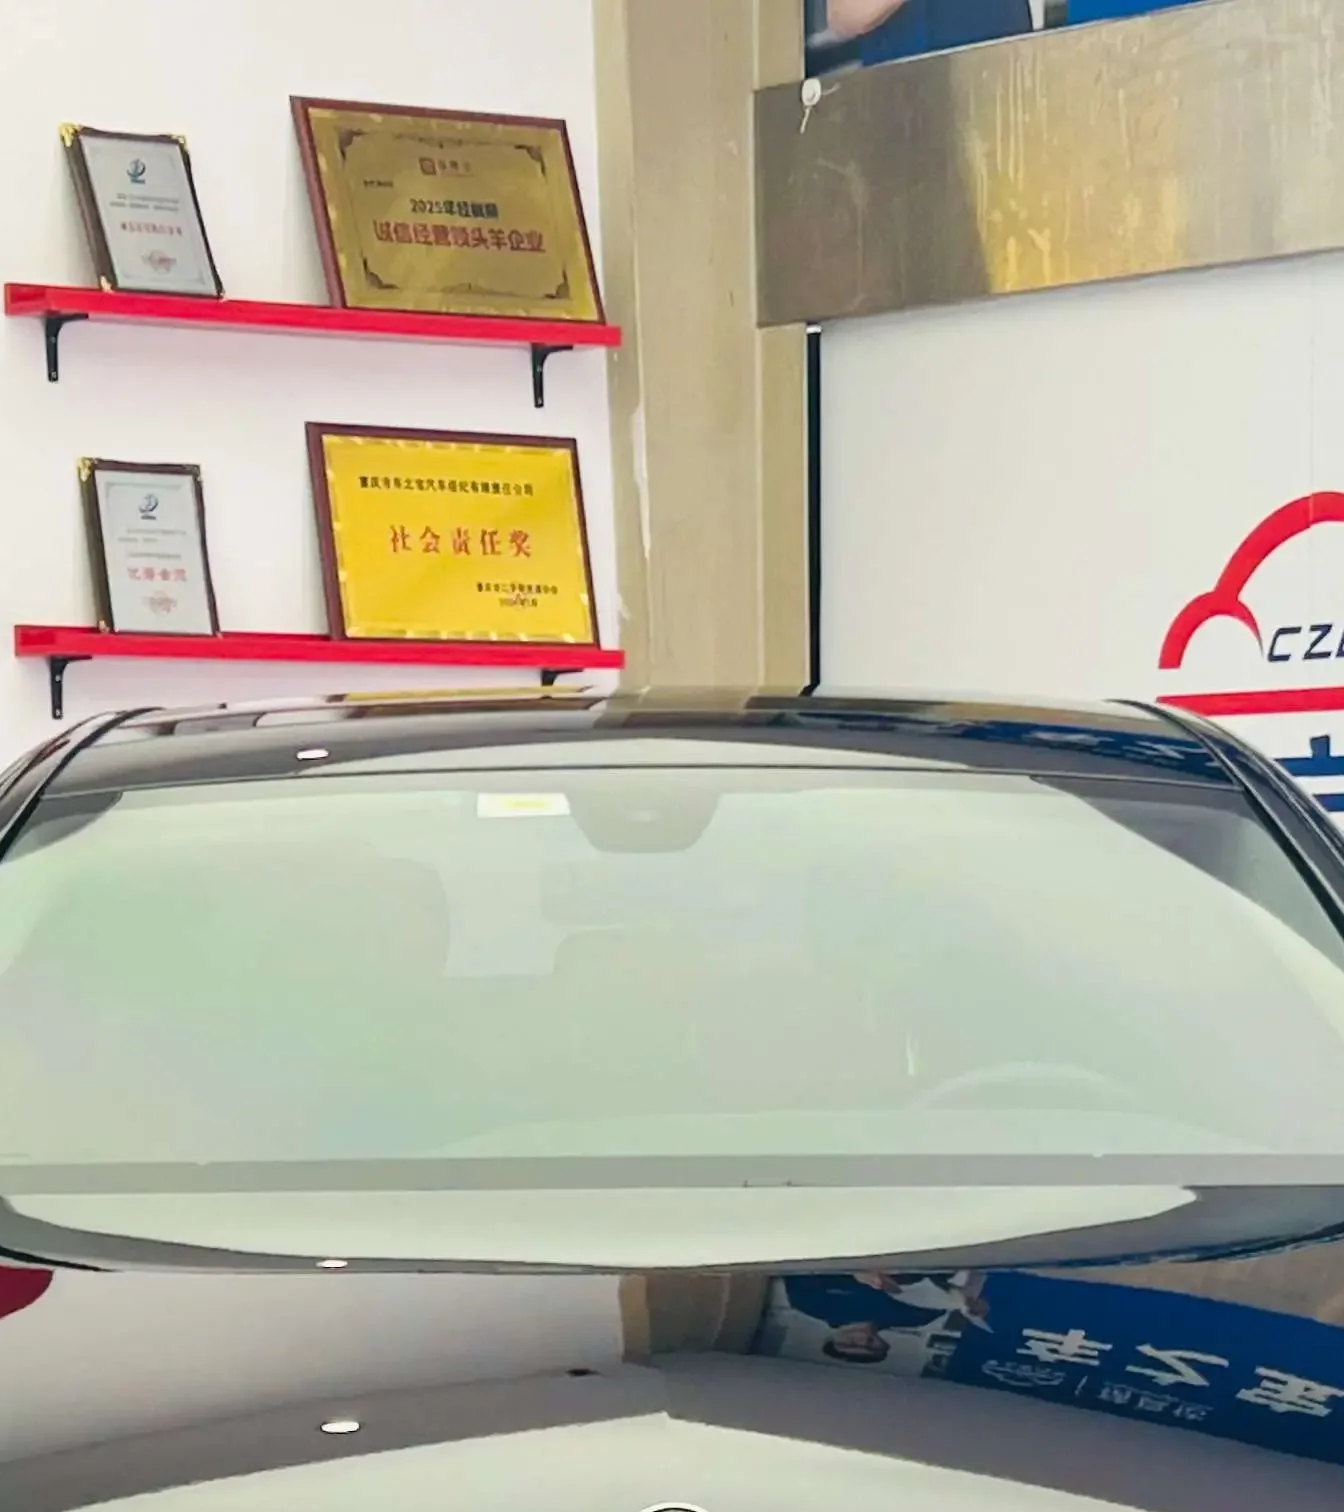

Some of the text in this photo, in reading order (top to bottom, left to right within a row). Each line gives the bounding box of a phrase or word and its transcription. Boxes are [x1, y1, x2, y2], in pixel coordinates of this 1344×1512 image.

[390, 524, 532, 558] 社会责任奖
